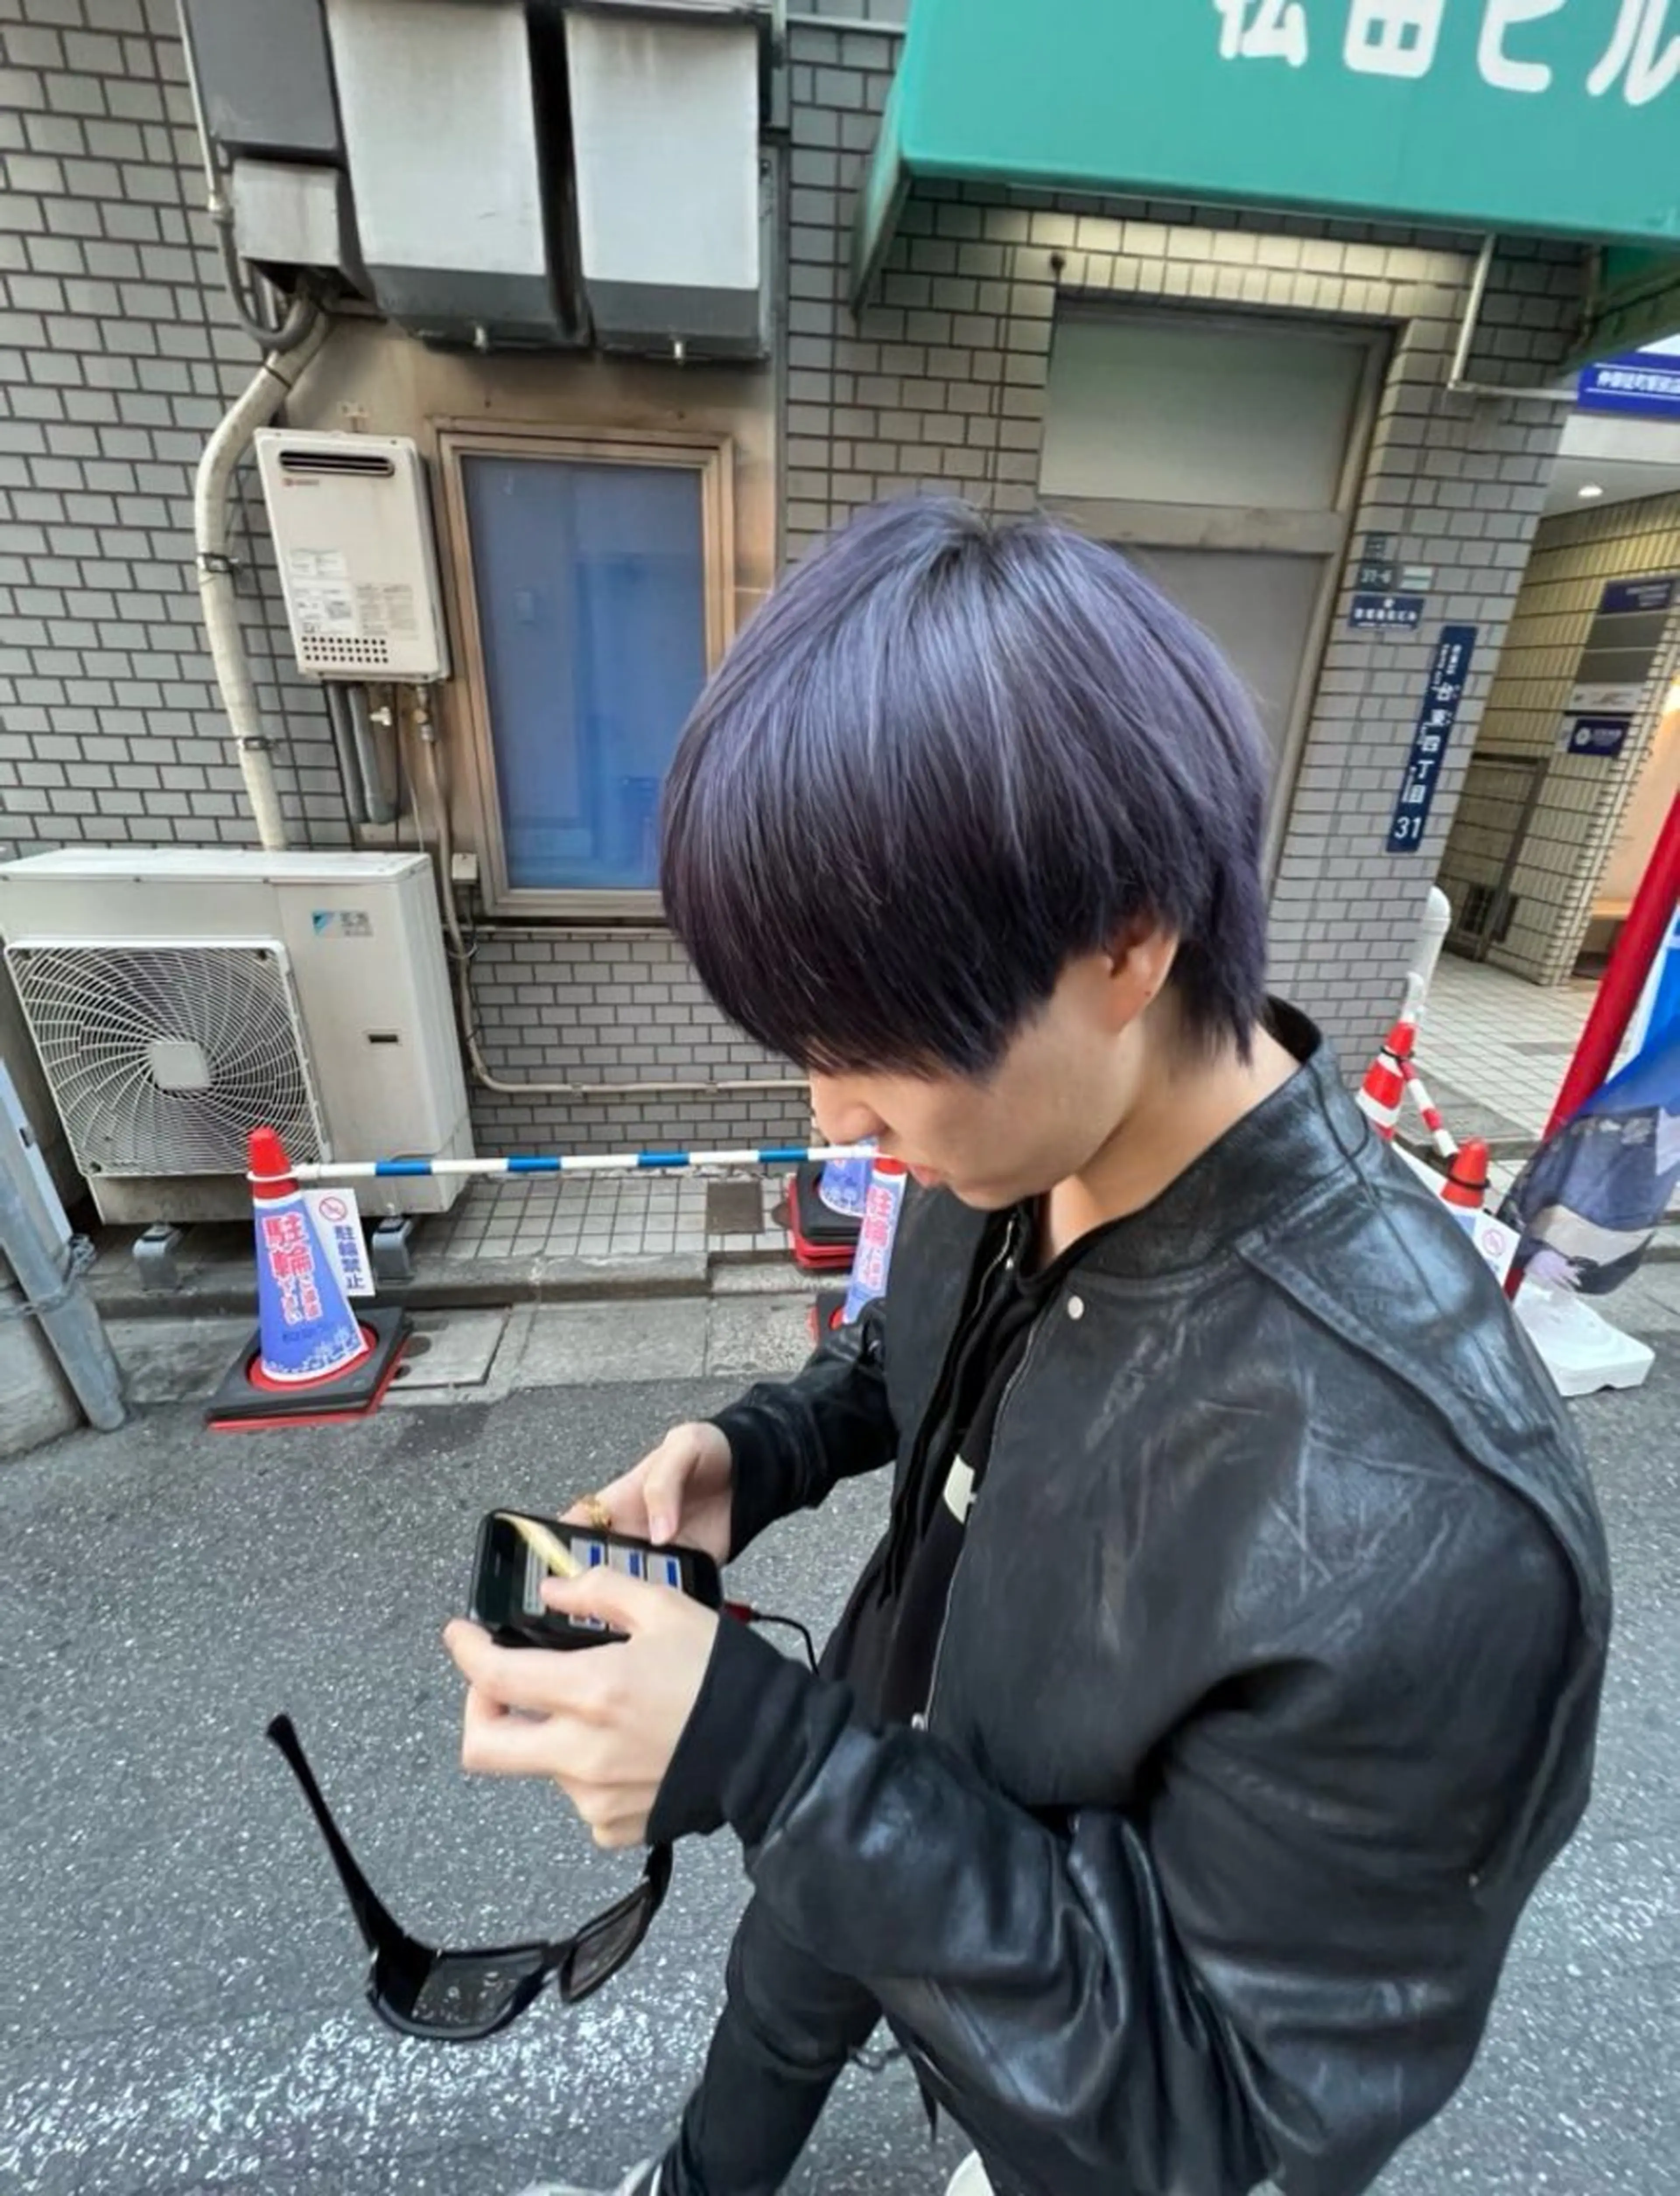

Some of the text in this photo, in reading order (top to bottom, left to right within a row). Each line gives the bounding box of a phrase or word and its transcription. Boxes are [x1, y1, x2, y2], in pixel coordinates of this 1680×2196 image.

[1394, 816, 1422, 840] 31
[334, 1225, 365, 1289] 駐輪禁止
